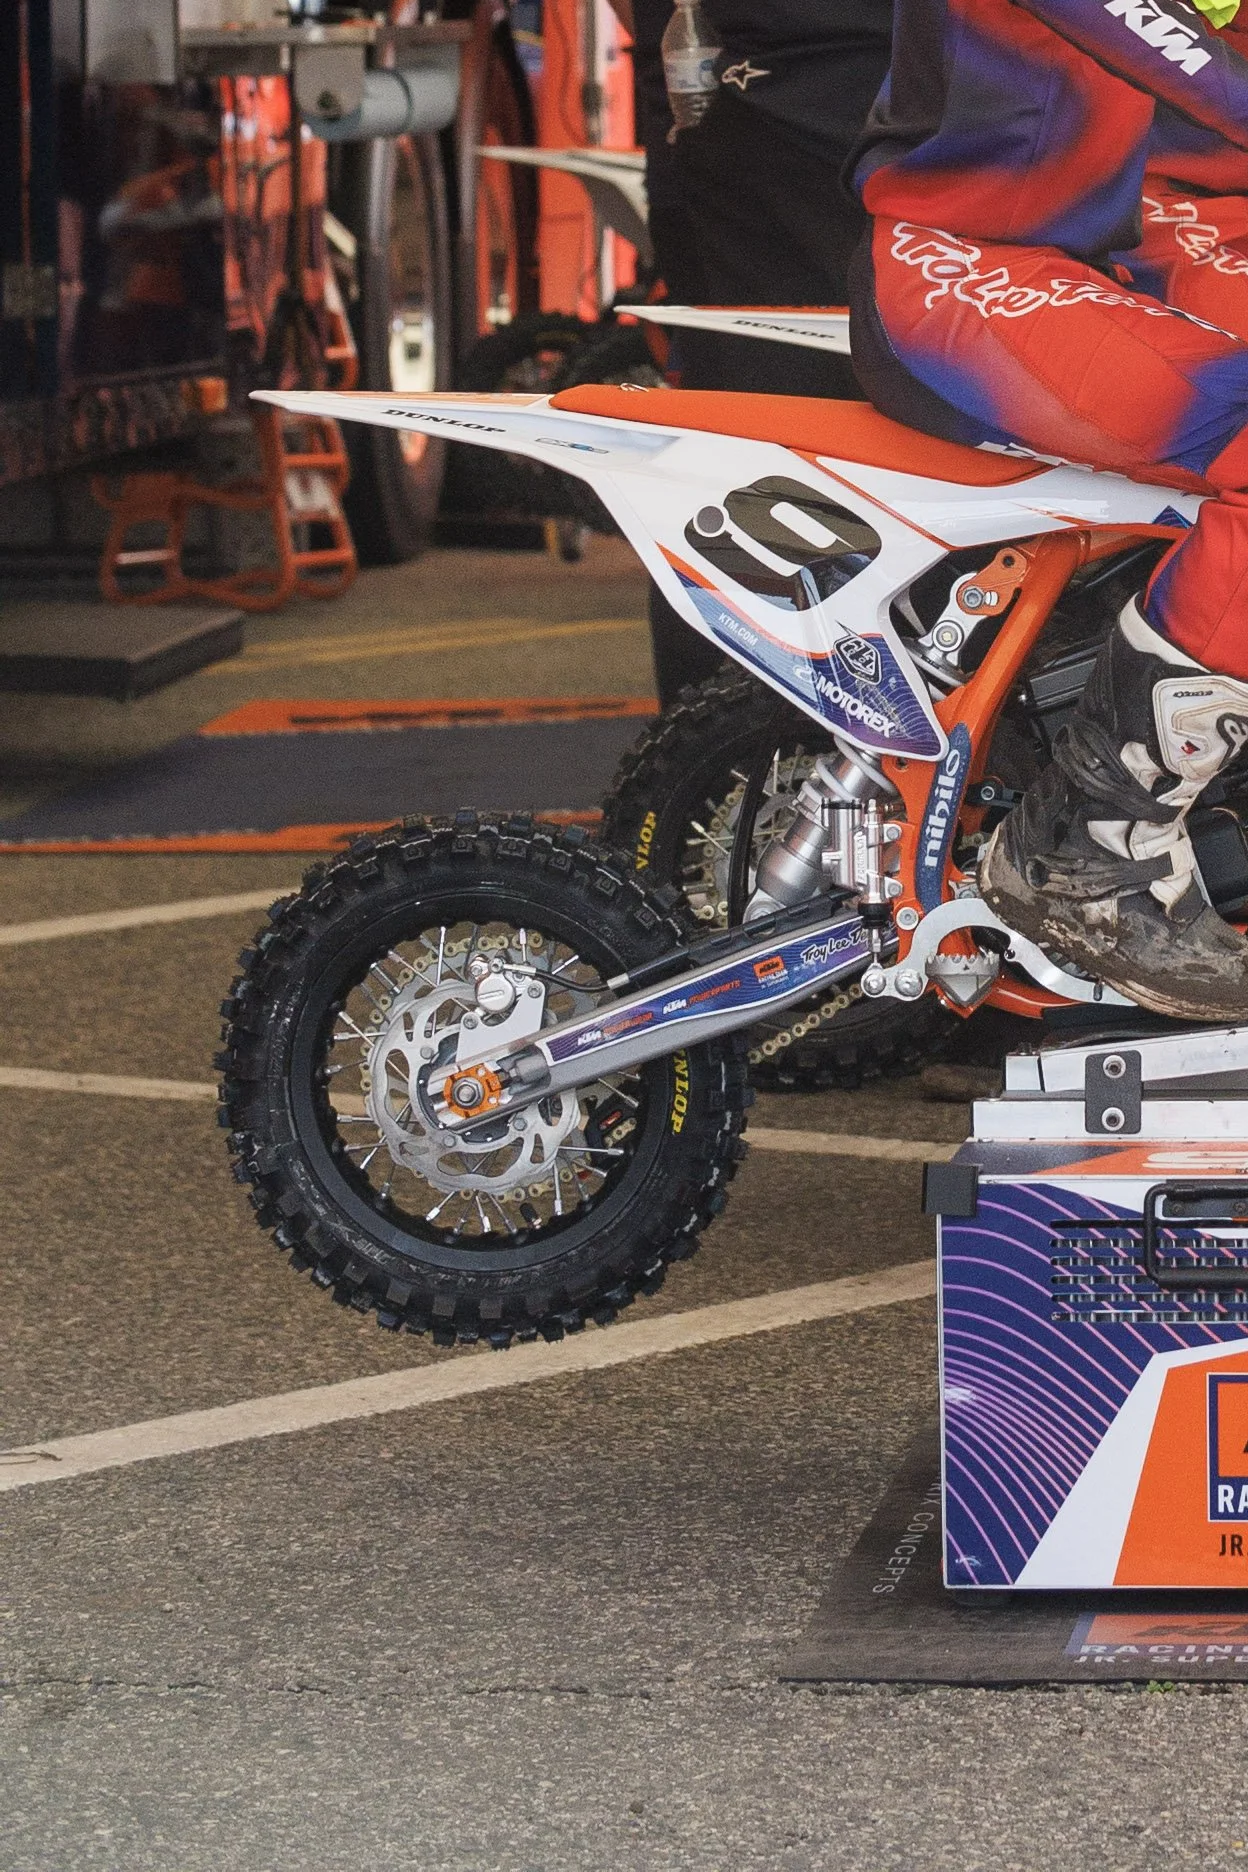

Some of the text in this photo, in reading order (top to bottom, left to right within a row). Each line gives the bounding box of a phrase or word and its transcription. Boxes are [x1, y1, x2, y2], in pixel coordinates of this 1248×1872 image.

[382, 409, 506, 433] DUNLOP
[718, 612, 759, 647] KTM.COM
[816, 675, 896, 738] MOTOREX
[801, 937, 850, 963] Troy Lee
[662, 999, 687, 1014] KTM
[872, 1512, 935, 1594] CONCEPTS
[1073, 1655, 1130, 1664] JR.
